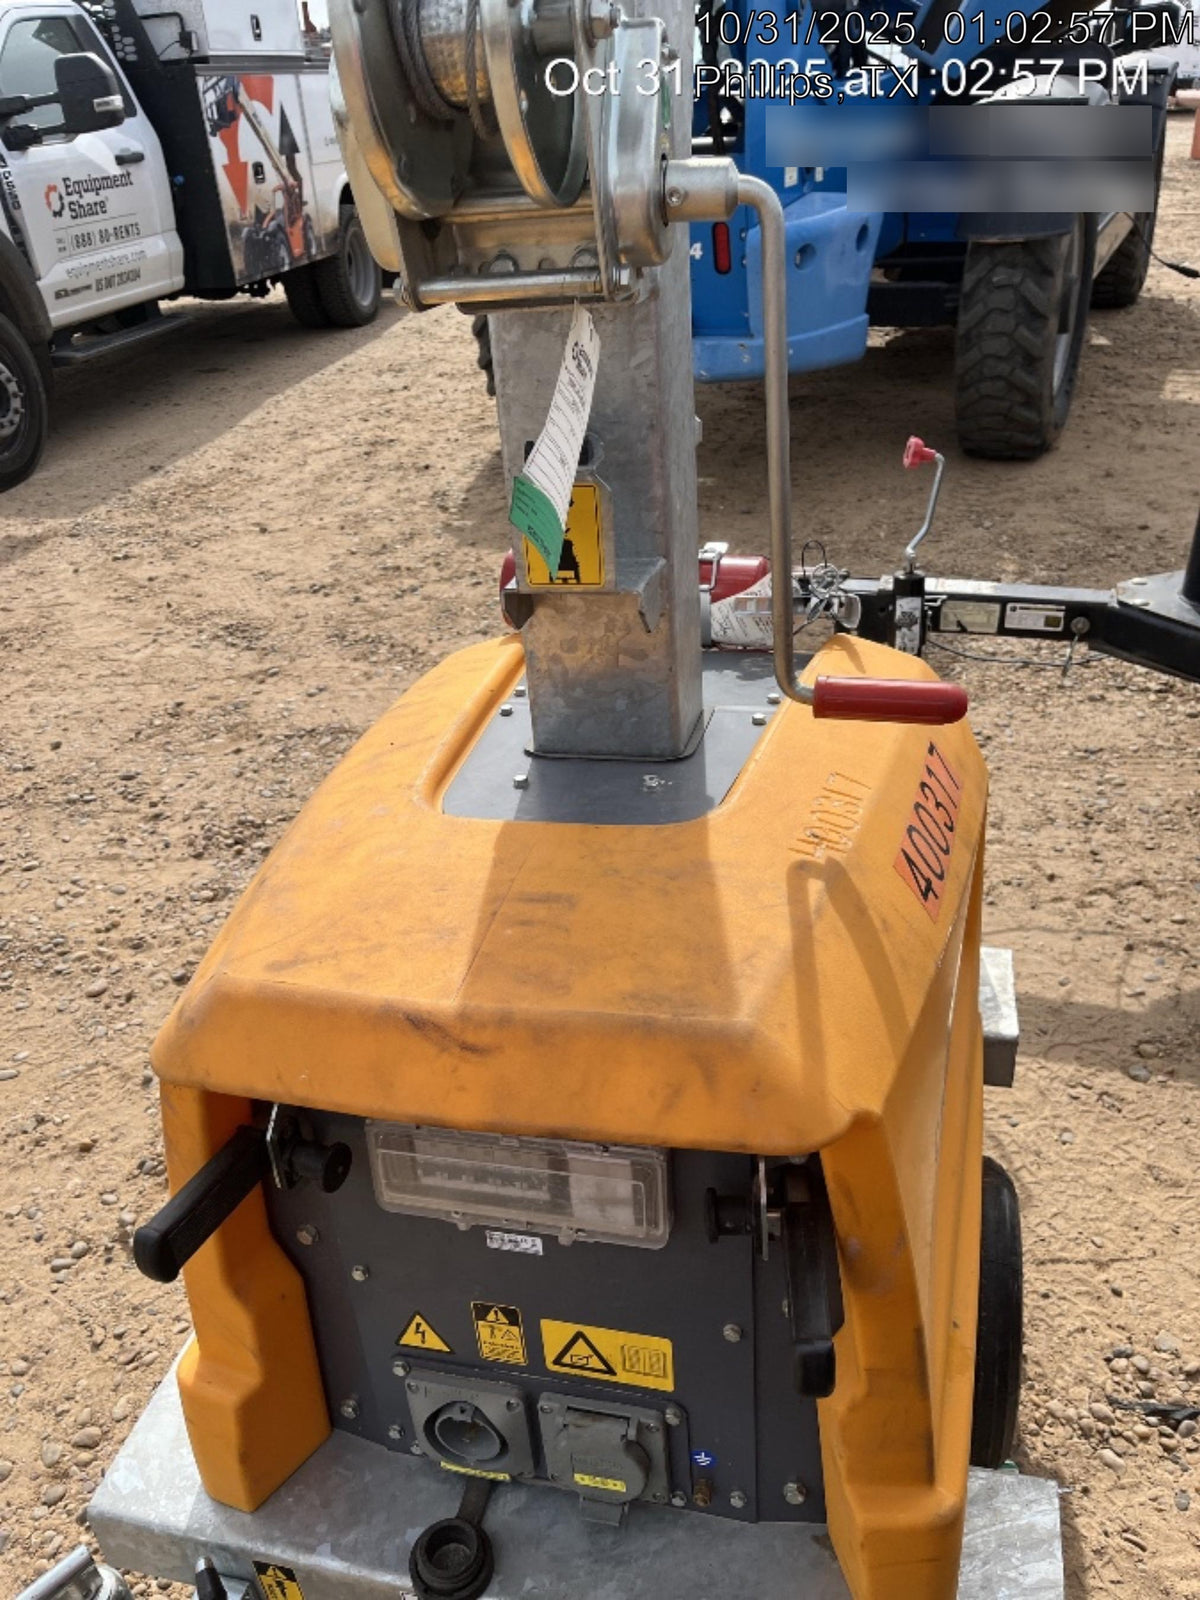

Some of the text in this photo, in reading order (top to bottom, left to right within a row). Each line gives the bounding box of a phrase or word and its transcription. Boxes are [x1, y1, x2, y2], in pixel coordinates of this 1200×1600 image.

[62, 169, 134, 199] Equipment
[68, 200, 107, 219] Share
[901, 741, 960, 902] 400317
